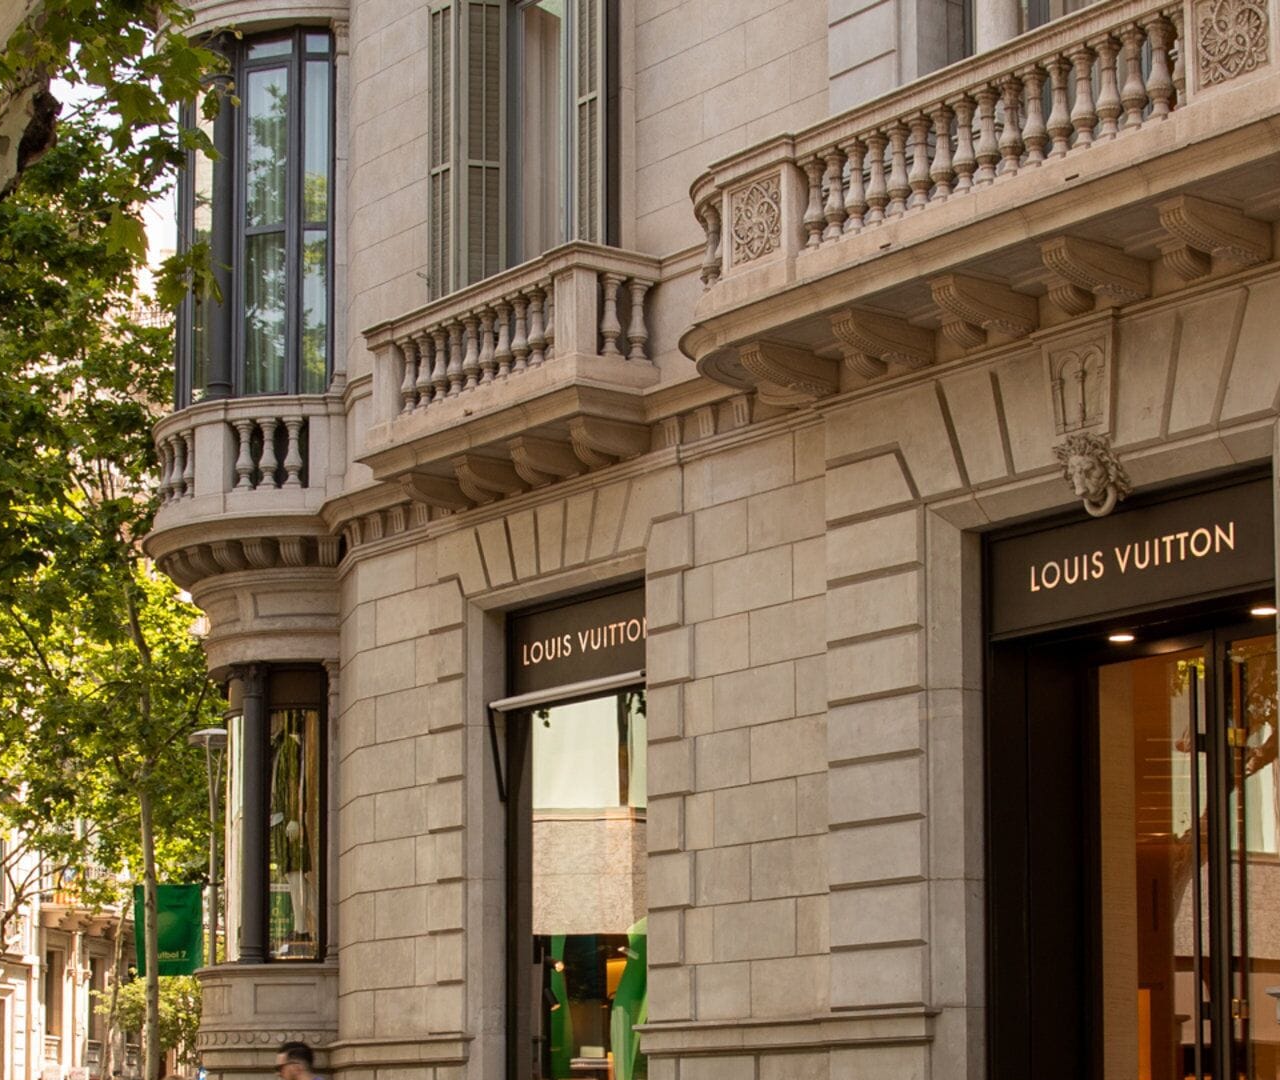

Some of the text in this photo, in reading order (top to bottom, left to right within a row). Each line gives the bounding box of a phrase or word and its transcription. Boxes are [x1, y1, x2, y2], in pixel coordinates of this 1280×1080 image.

[1030, 521, 1236, 592] LOUIS VUITTON
[523, 635, 572, 666] LOUIS
[157, 950, 187, 960] utbol 7
